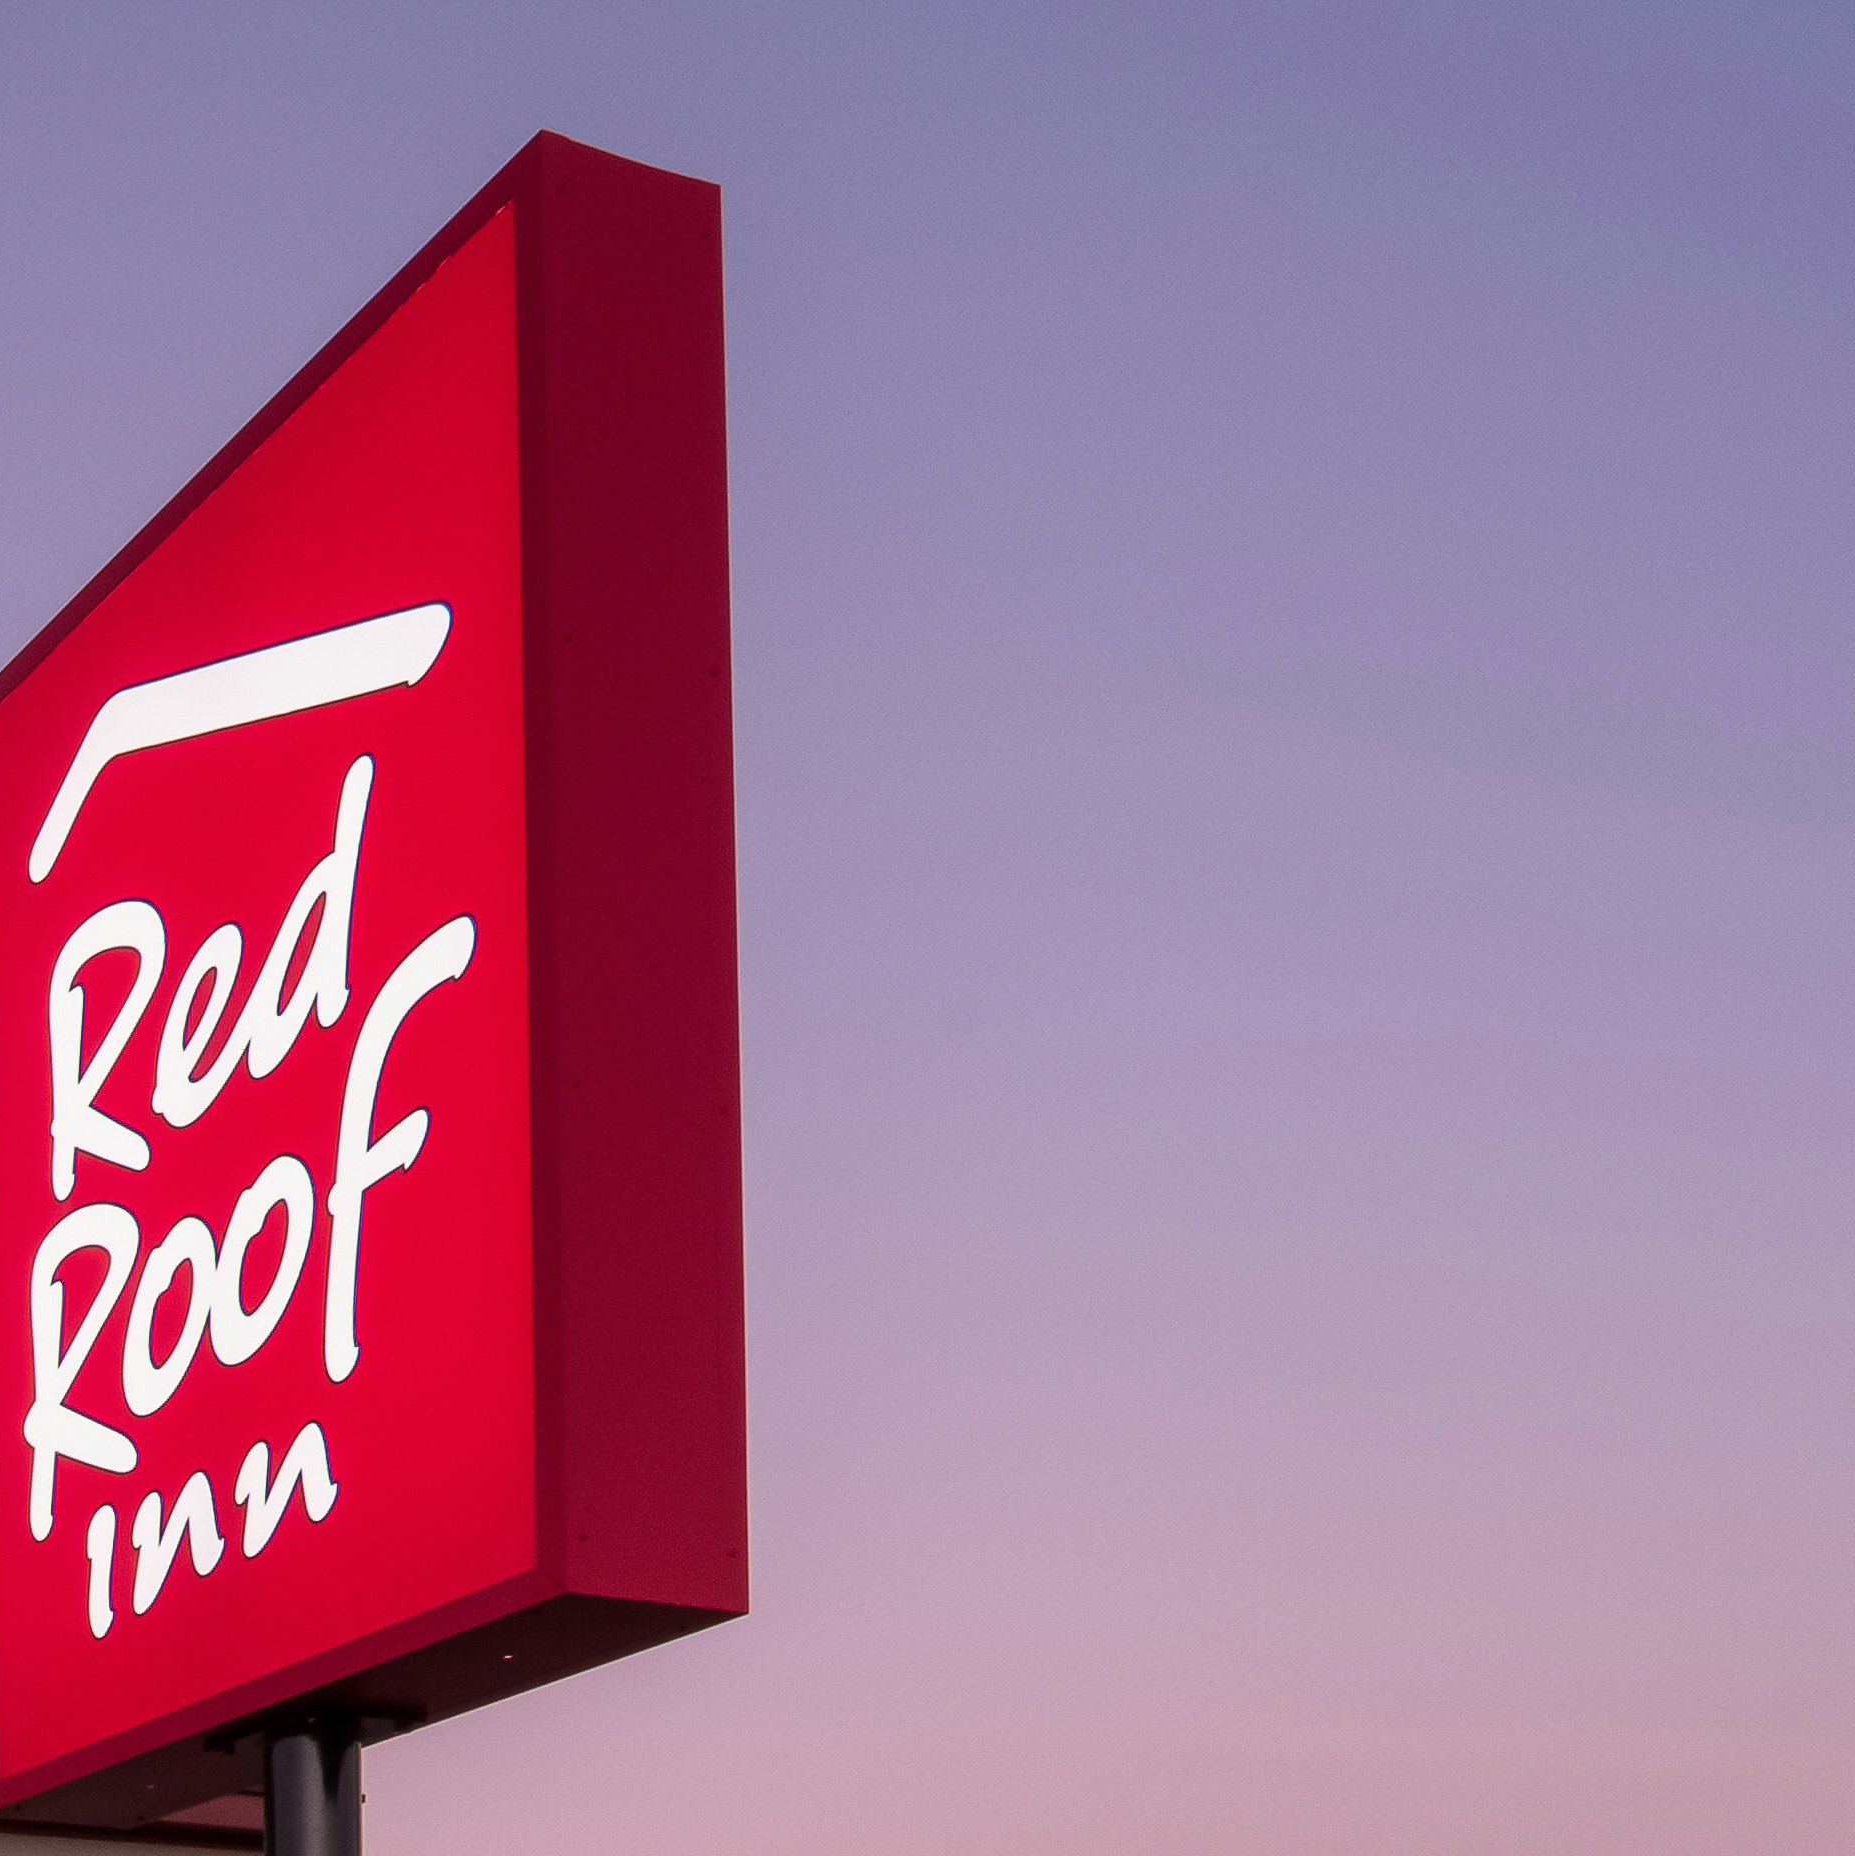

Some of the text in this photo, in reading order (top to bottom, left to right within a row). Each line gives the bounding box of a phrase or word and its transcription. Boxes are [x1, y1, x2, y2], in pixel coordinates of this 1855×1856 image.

[49, 753, 375, 1201] Red
[22, 914, 476, 1541] Roof
[86, 1420, 339, 1639] inn
